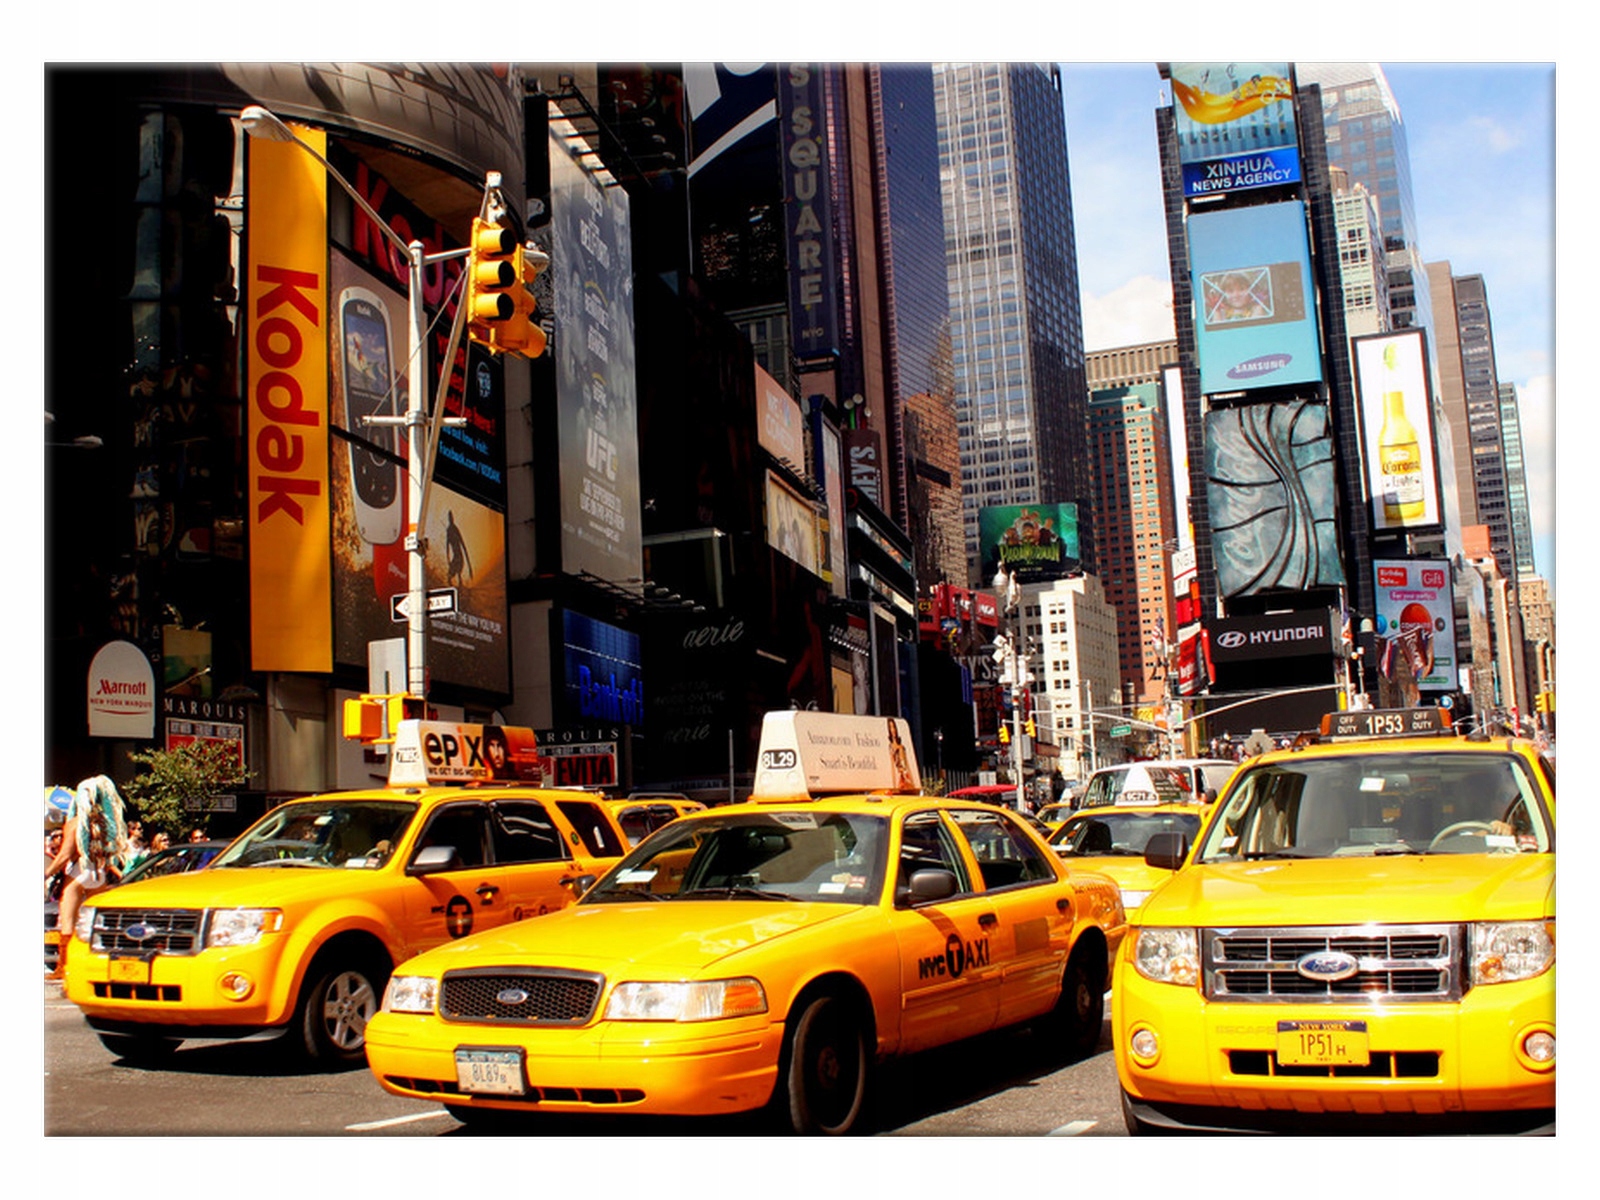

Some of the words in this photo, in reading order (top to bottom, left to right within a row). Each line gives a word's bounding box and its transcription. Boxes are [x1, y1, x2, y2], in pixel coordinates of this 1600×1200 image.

[1207, 157, 1275, 179] XINHUA
[1192, 177, 1232, 192] NEWS
[1234, 169, 1292, 187] AGENCY
[789, 106, 823, 306] SQUARE
[802, 328, 824, 339] NYC
[1235, 359, 1285, 374] SAMSUNG
[256, 264, 321, 526] Kodak
[586, 427, 616, 482] UFC
[1382, 461, 1420, 475] Corona
[1423, 572, 1443, 585] Gift
[682, 615, 746, 650] aerie
[1249, 625, 1324, 645] HYUNDAI
[96, 679, 147, 695] Marriott
[124, 699, 152, 708] MARQUIS
[163, 697, 246, 720] MARQUIS
[1339, 716, 1355, 724] OFF
[1413, 711, 1429, 720] OFF
[1337, 724, 1358, 734] DUTY
[1365, 714, 1405, 735] 1P53
[1411, 720, 1433, 730] DUTY
[428, 767, 438, 775] WE
[440, 768, 452, 776] GET
[453, 768, 464, 776] BIG
[557, 755, 612, 786] EVITA
[918, 954, 946, 980] NYC
[948, 936, 990, 975] TAXI
[1298, 1023, 1320, 1031] NEW
[1322, 1023, 1346, 1031] YORK
